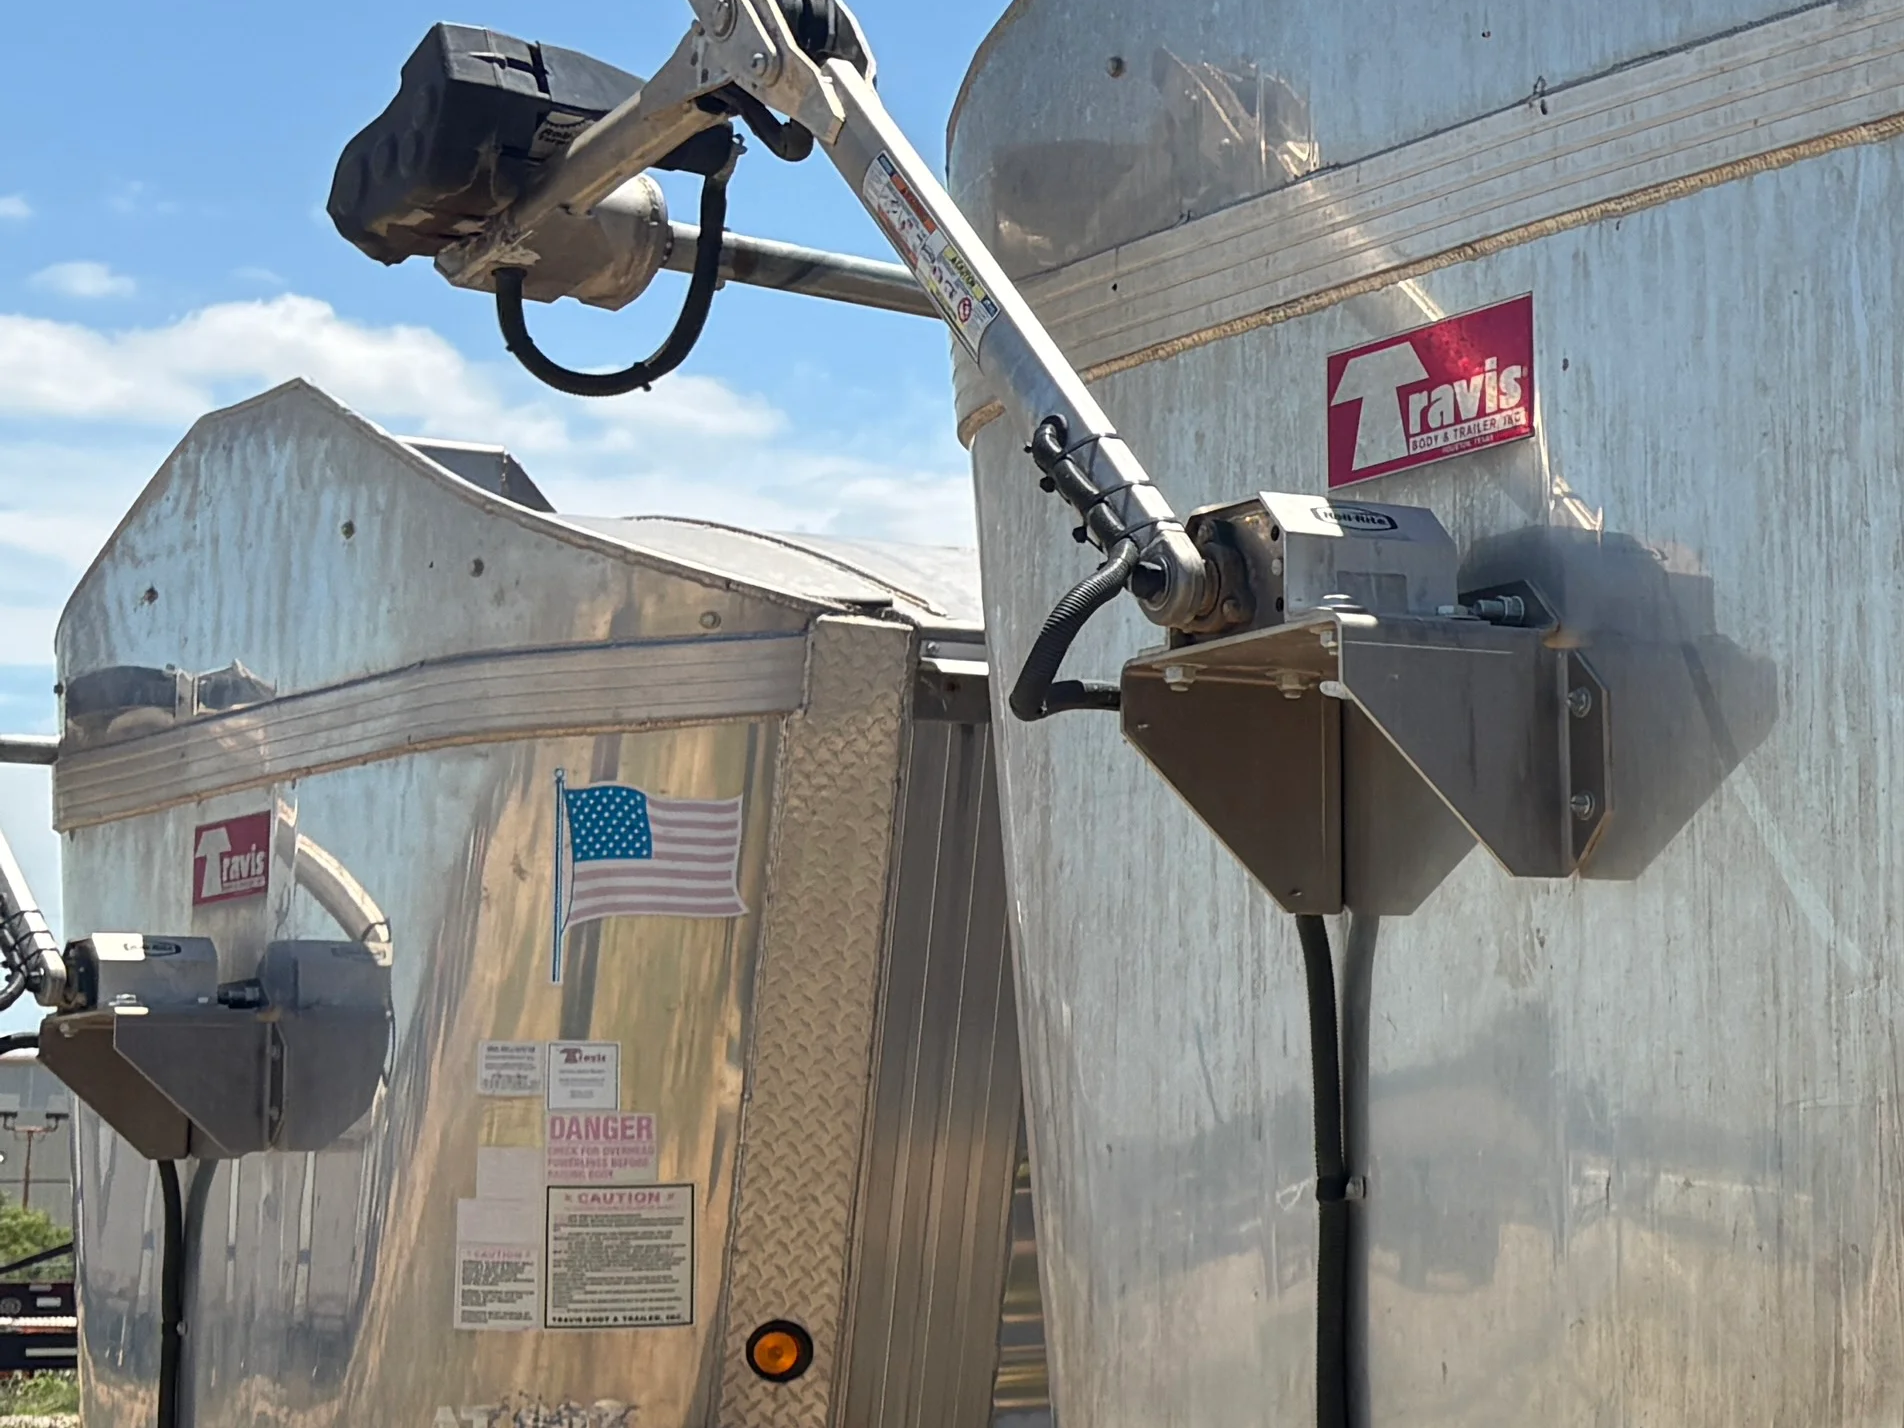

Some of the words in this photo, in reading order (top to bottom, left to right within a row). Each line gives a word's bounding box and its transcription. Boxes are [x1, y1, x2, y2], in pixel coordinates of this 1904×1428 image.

[1330, 342, 1521, 471] Travis
[1412, 437, 1439, 450] BODY
[1443, 434, 1449, 442] &
[195, 827, 265, 898] Travis
[550, 1115, 653, 1140] DANGER
[578, 1192, 661, 1204] CAUTION
